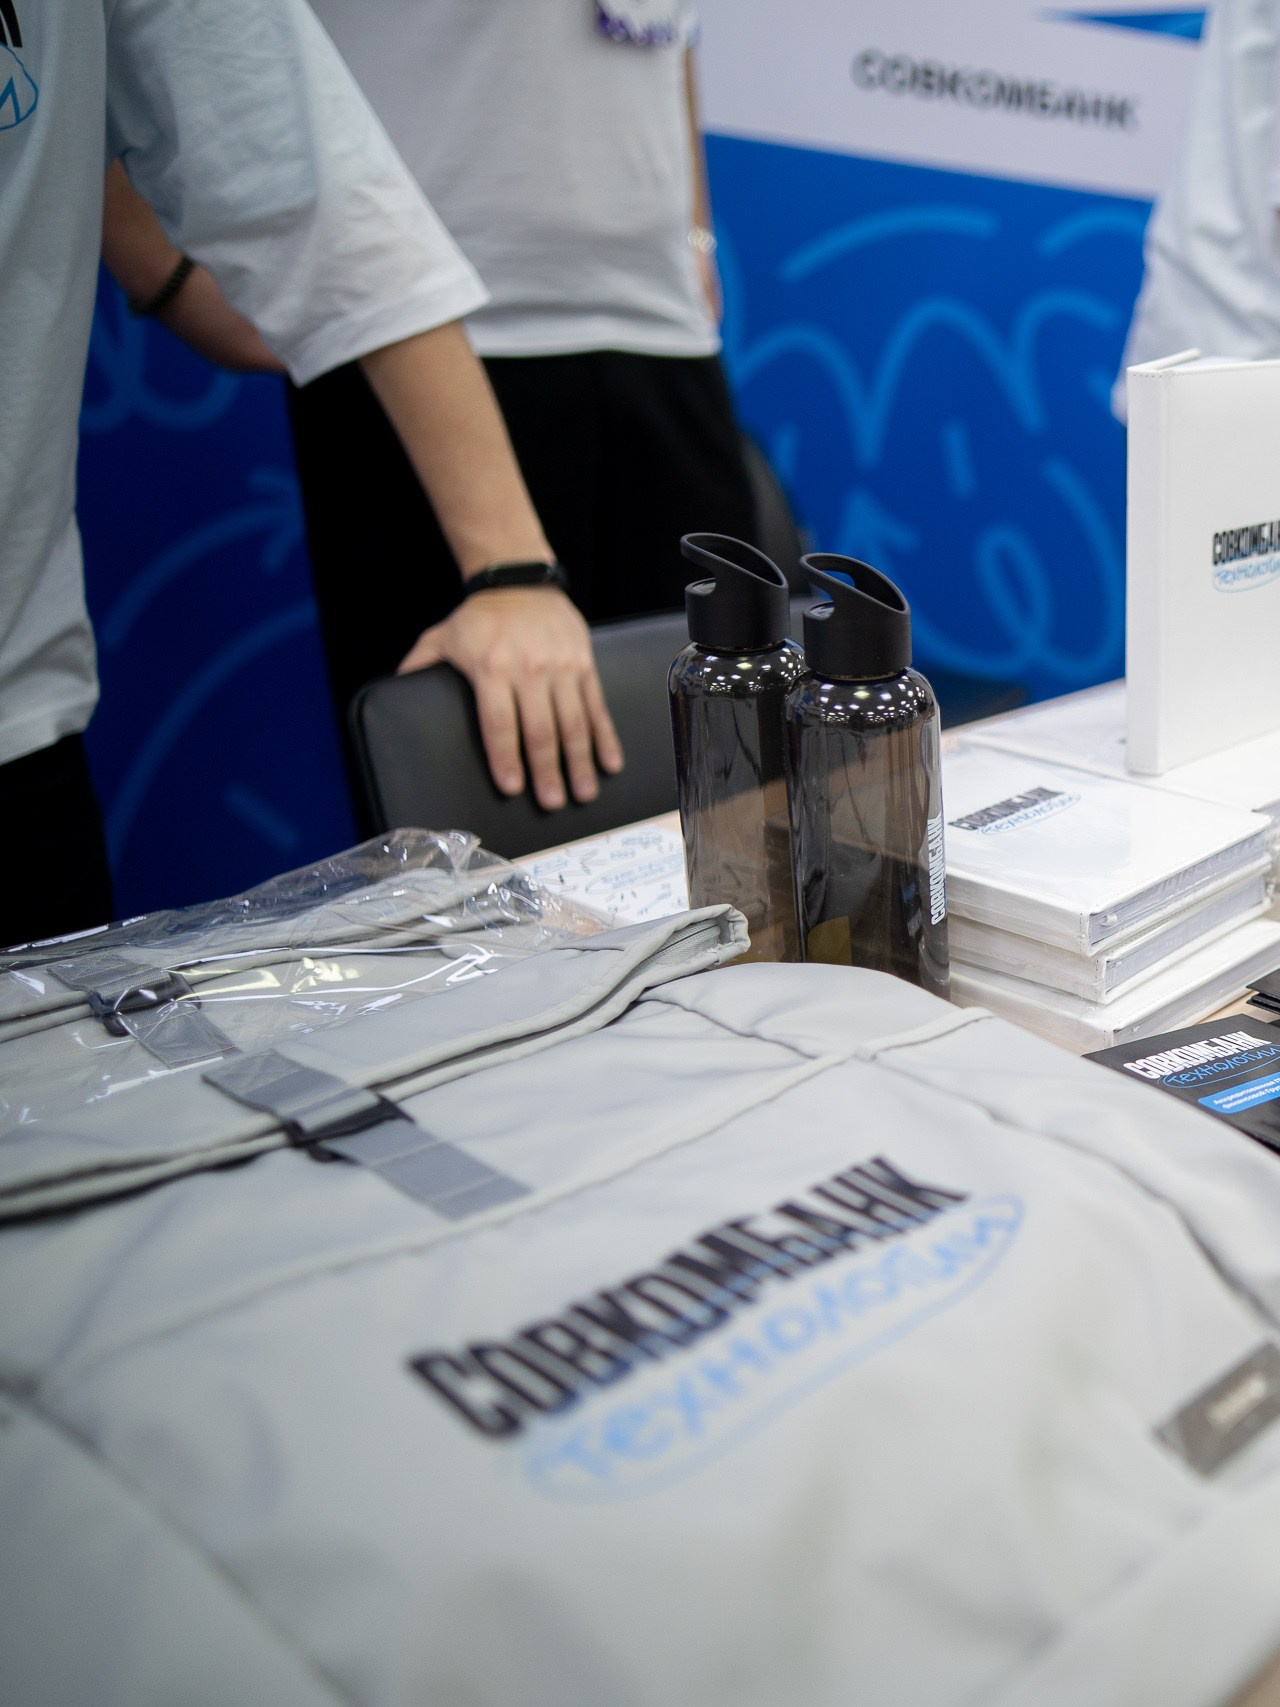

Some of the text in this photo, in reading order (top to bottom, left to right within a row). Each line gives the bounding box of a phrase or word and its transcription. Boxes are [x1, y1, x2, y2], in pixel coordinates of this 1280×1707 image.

[852, 47, 1138, 132] СОВКОМБАНК
[947, 785, 1065, 831] СОВКОМБАНК
[927, 811, 947, 926] СОВКОМБАНК
[1122, 1031, 1273, 1080] СОВКОМБАНК
[405, 1153, 972, 1446] СОВКОМБАНК
